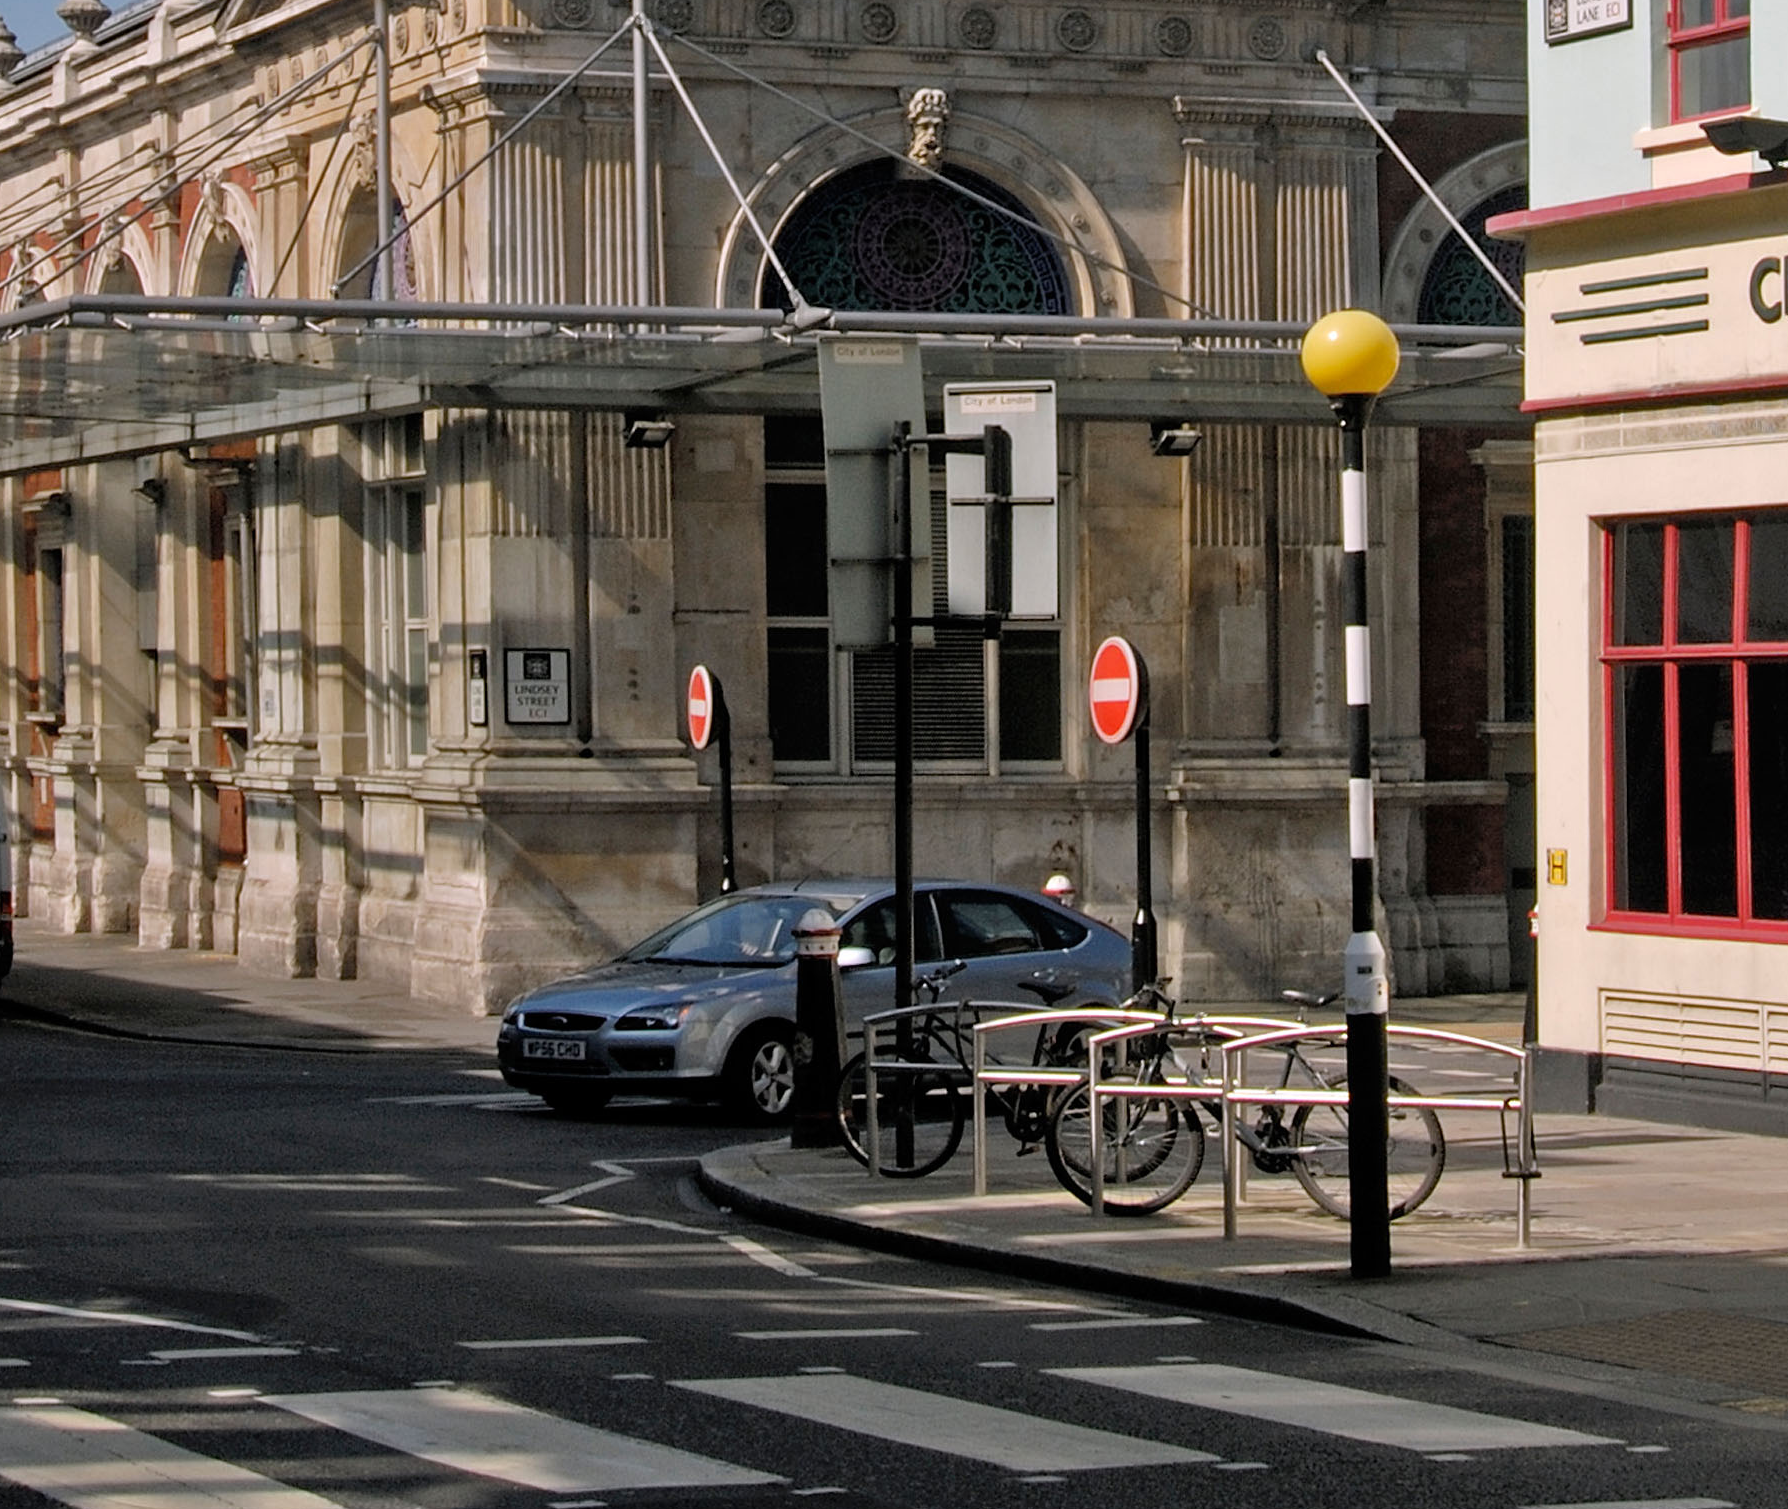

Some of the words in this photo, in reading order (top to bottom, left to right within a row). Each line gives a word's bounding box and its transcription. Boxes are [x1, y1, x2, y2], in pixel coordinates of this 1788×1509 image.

[1576, 5, 1600, 24] LANE
[837, 347, 855, 357] City
[860, 347, 867, 356] of
[871, 348, 900, 357] London
[964, 396, 983, 407] City
[988, 395, 996, 405] of
[1000, 395, 1032, 405] London
[514, 685, 559, 695] LINDSEY
[517, 696, 557, 707] STREET
